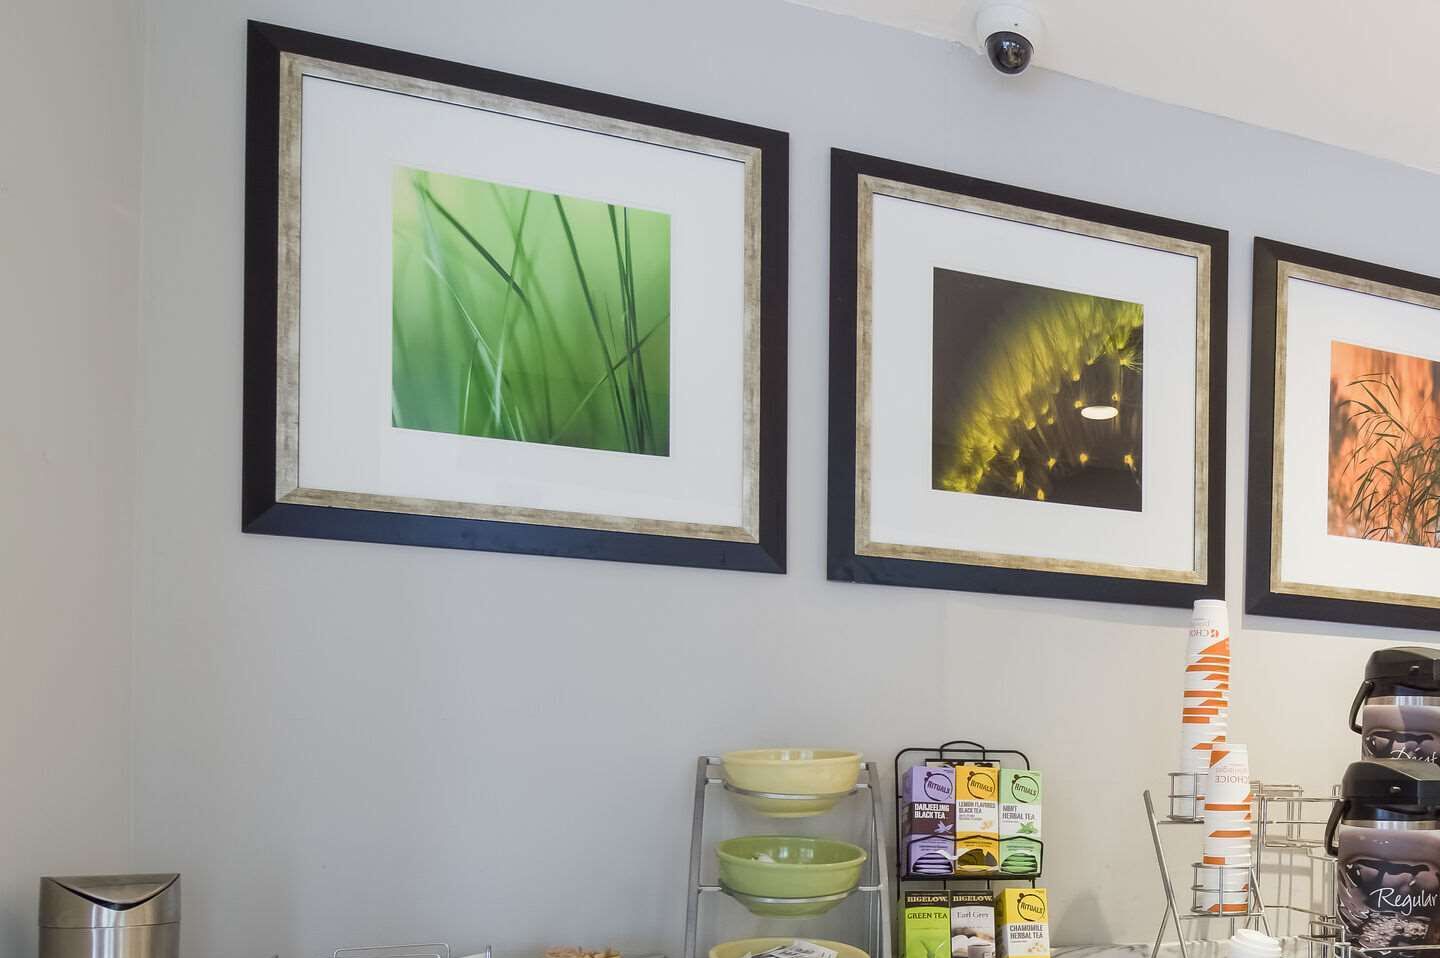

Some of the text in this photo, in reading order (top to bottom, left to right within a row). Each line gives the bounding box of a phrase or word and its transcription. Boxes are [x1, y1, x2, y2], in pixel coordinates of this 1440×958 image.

[1215, 775, 1249, 784] CHOICE
[927, 780, 950, 795] RITUALS
[970, 779, 993, 793] RITUALS
[1014, 783, 1037, 797] RITUALS
[914, 803, 950, 812] DARJEELING
[914, 811, 946, 819] BLACK TEA
[1002, 812, 1024, 820] HERBAL
[1369, 887, 1438, 916] Regular
[1020, 902, 1043, 914] RITUALS
[907, 912, 933, 920] GREEN
[957, 911, 971, 919] Earl
[1009, 924, 1043, 932] CHAMOMILE
